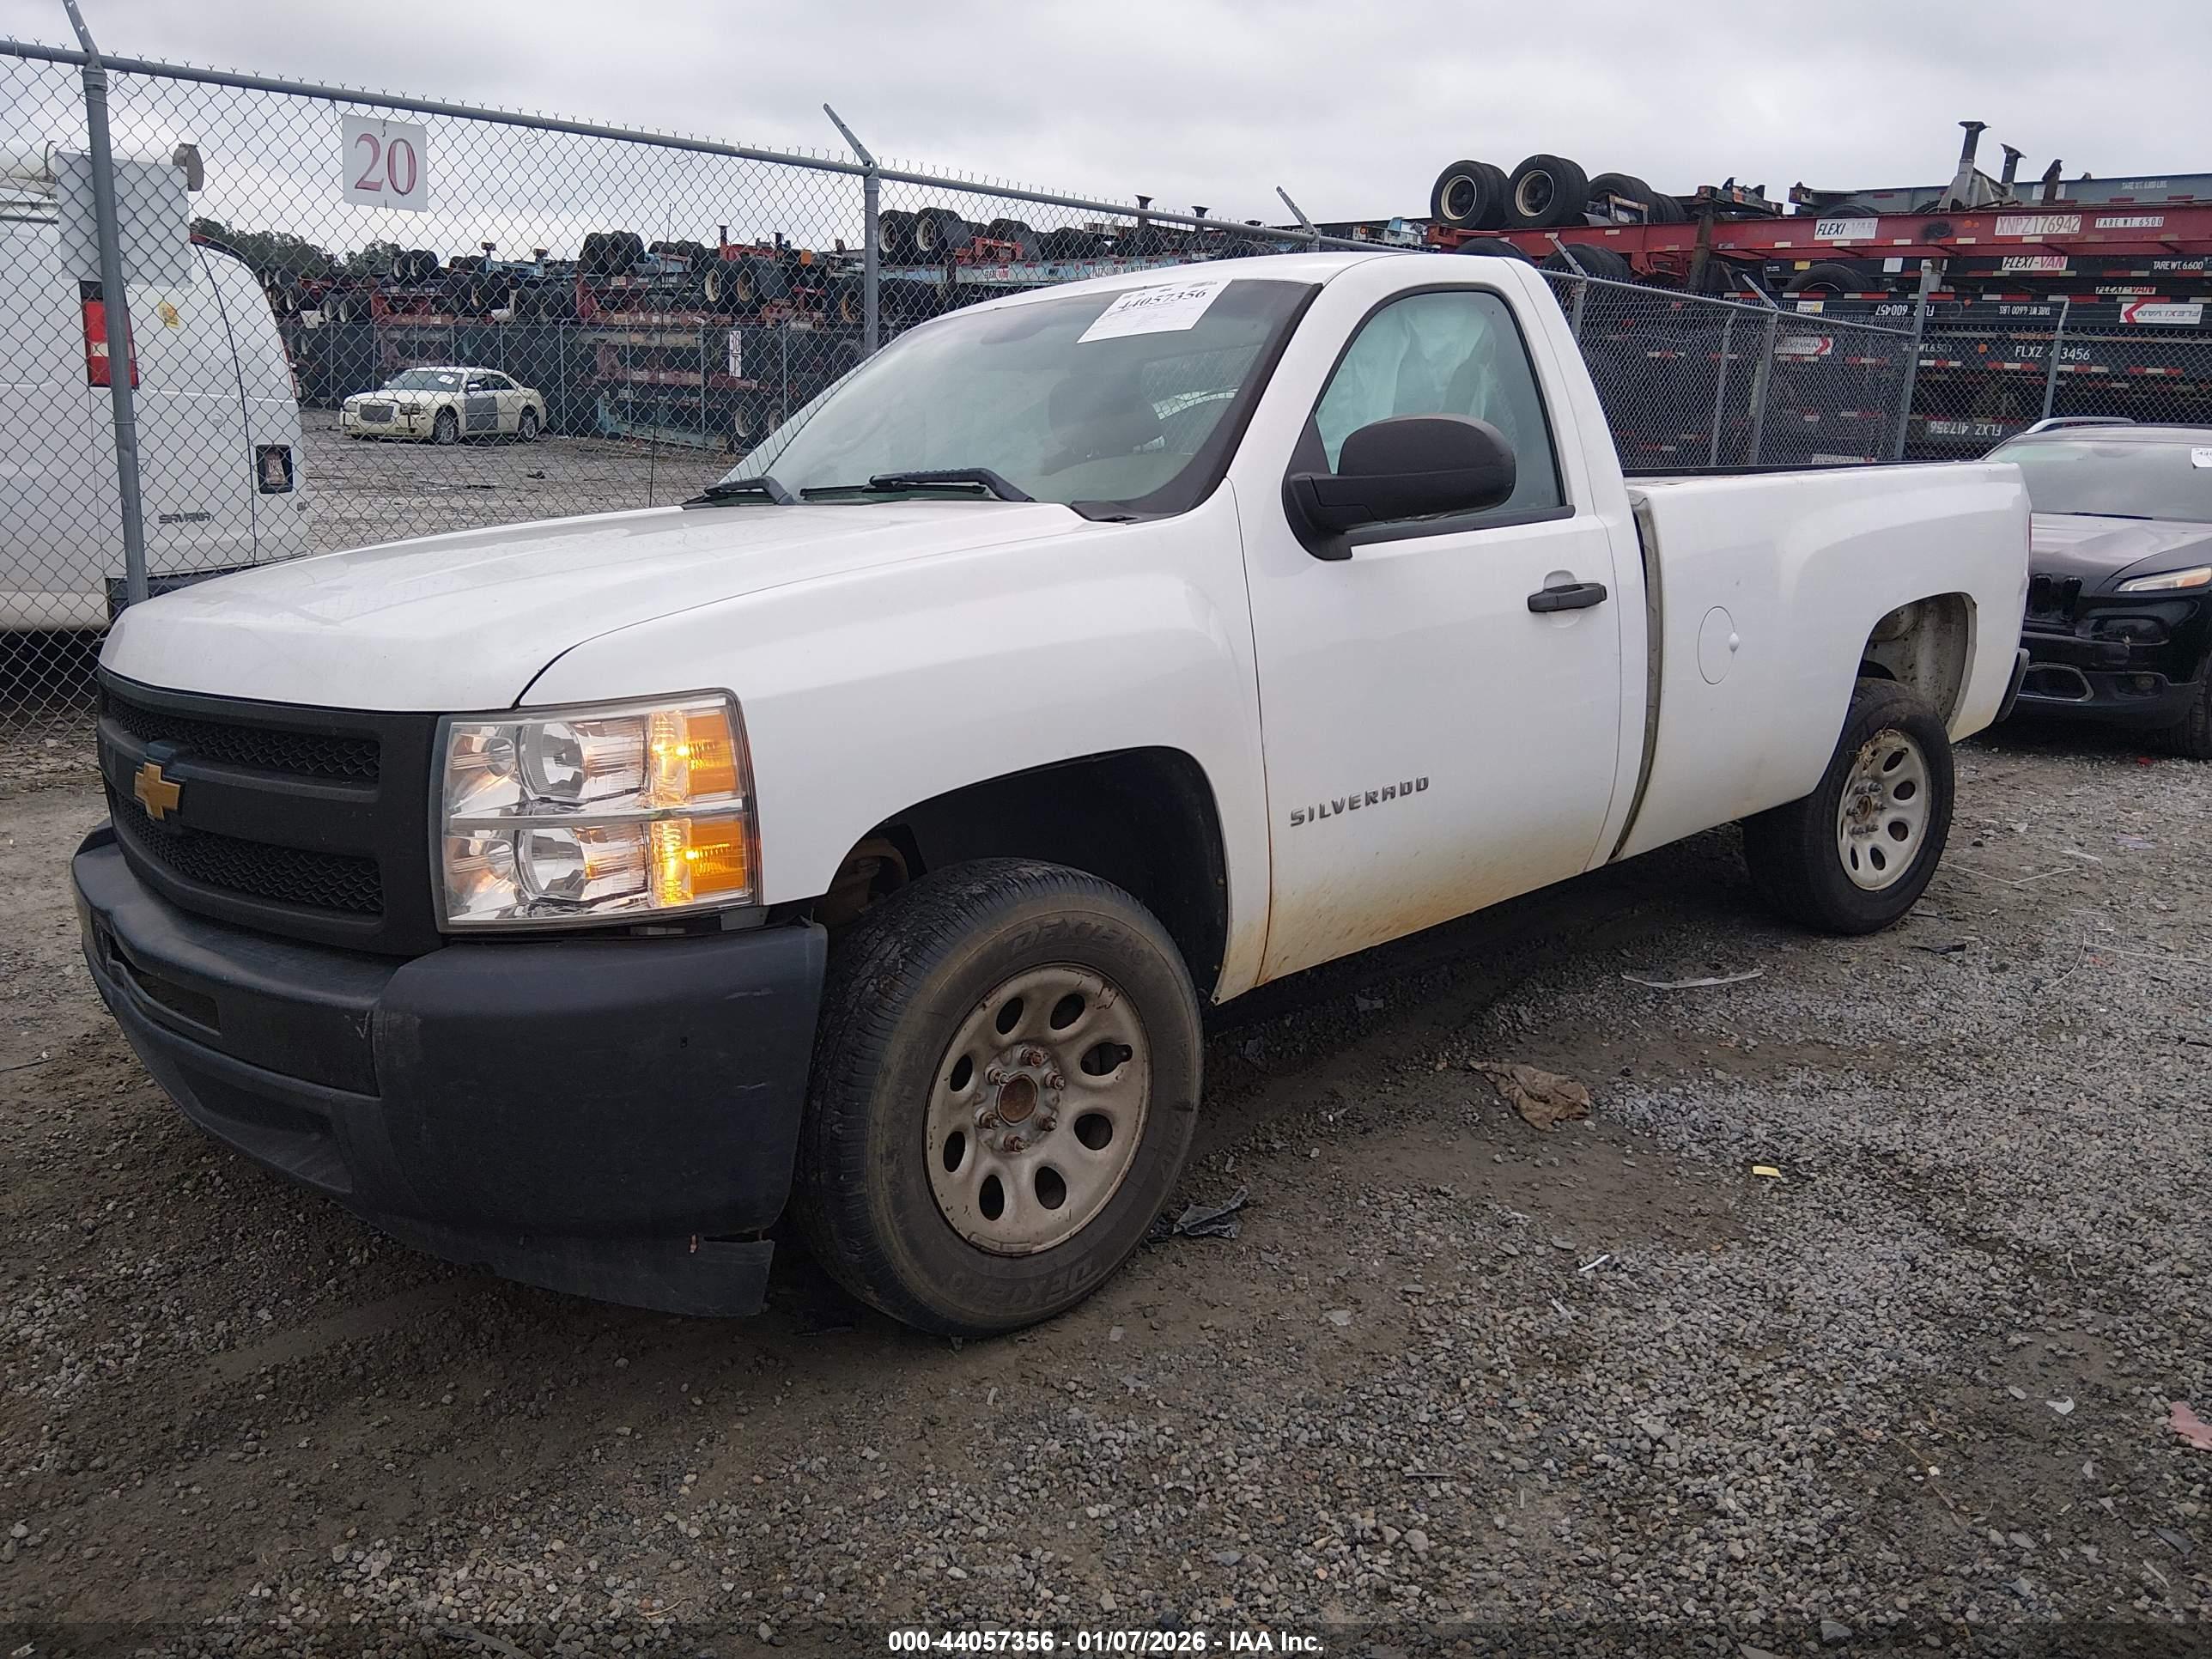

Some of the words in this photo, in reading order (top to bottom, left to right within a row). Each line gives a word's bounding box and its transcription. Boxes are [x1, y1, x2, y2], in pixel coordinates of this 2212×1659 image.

[355, 133, 416, 197] 20
[2097, 217, 2119, 228] TARE
[2139, 216, 2163, 227] 6500
[2002, 256, 2067, 269] FLEXI-VAN
[2153, 260, 2168, 270] TARE
[1117, 288, 1209, 309] 44057356
[1875, 304, 1908, 317] 600457
[1914, 304, 1936, 318] FLZ
[2014, 345, 2044, 358] FLXZ
[2049, 346, 2091, 361] 43456
[1930, 421, 1969, 435] 417356
[1974, 423, 2002, 436] FLXZ
[1290, 775, 1430, 828] SILVERADO
